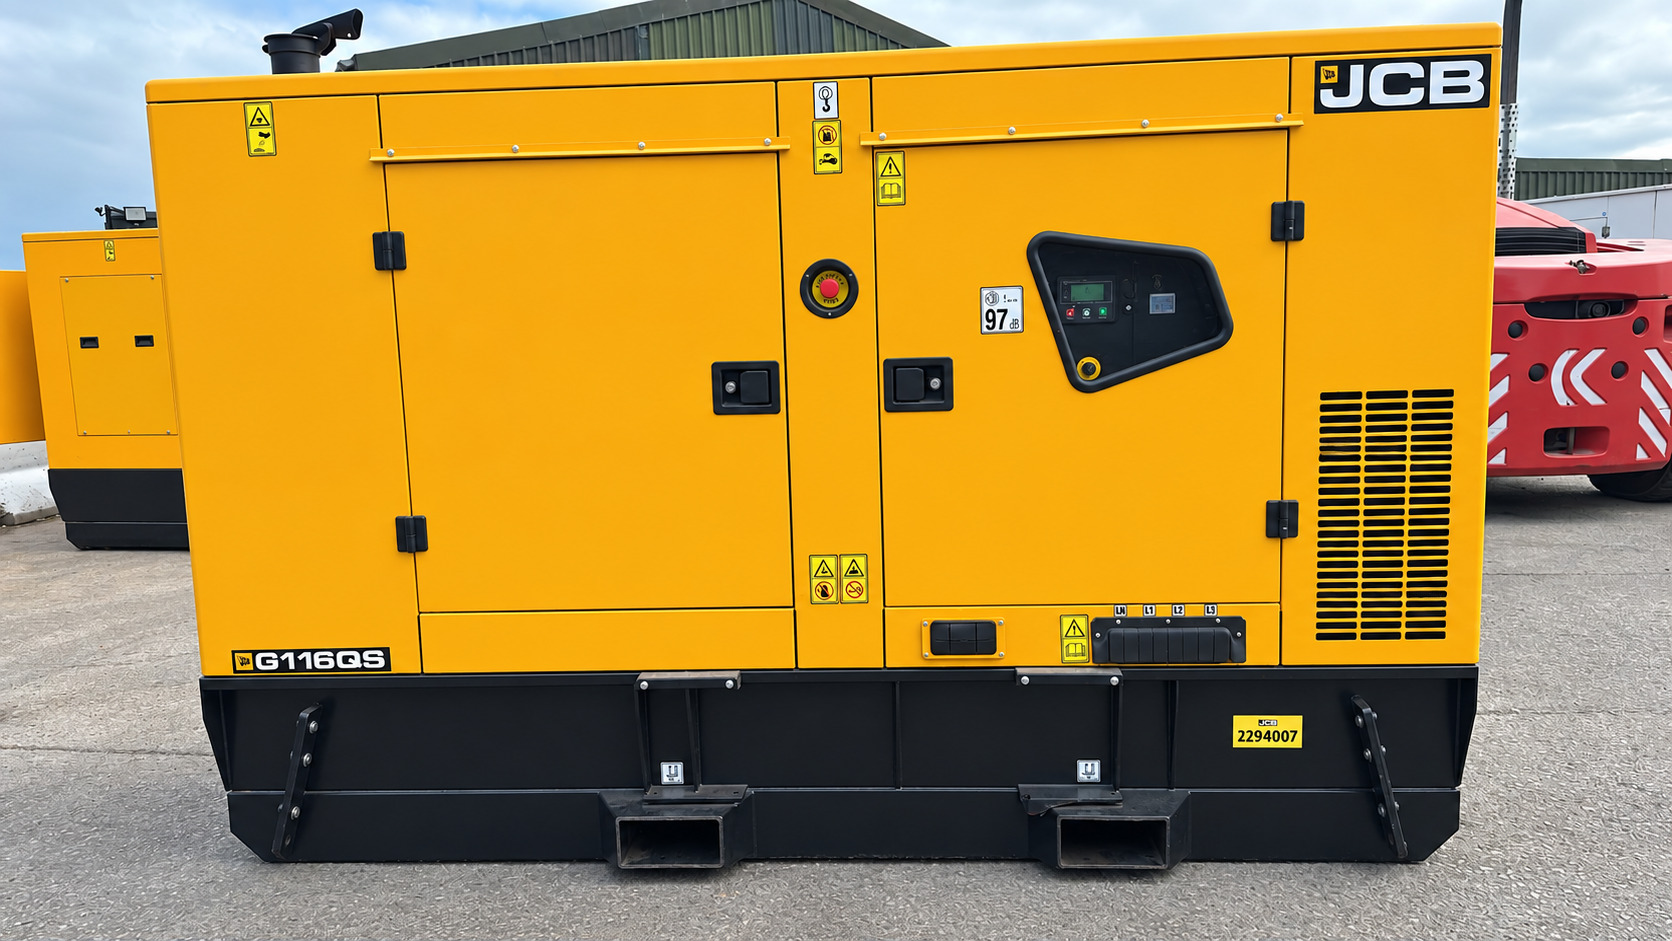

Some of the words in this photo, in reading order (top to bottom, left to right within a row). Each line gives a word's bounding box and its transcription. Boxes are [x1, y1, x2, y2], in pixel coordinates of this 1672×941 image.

[1319, 60, 1485, 108] JCB
[985, 308, 1008, 331] 97
[1009, 318, 1020, 330] dB
[1145, 606, 1154, 615] L1
[1174, 606, 1183, 615] L2
[255, 650, 386, 671] G116QS
[1237, 730, 1298, 743] 2294007
